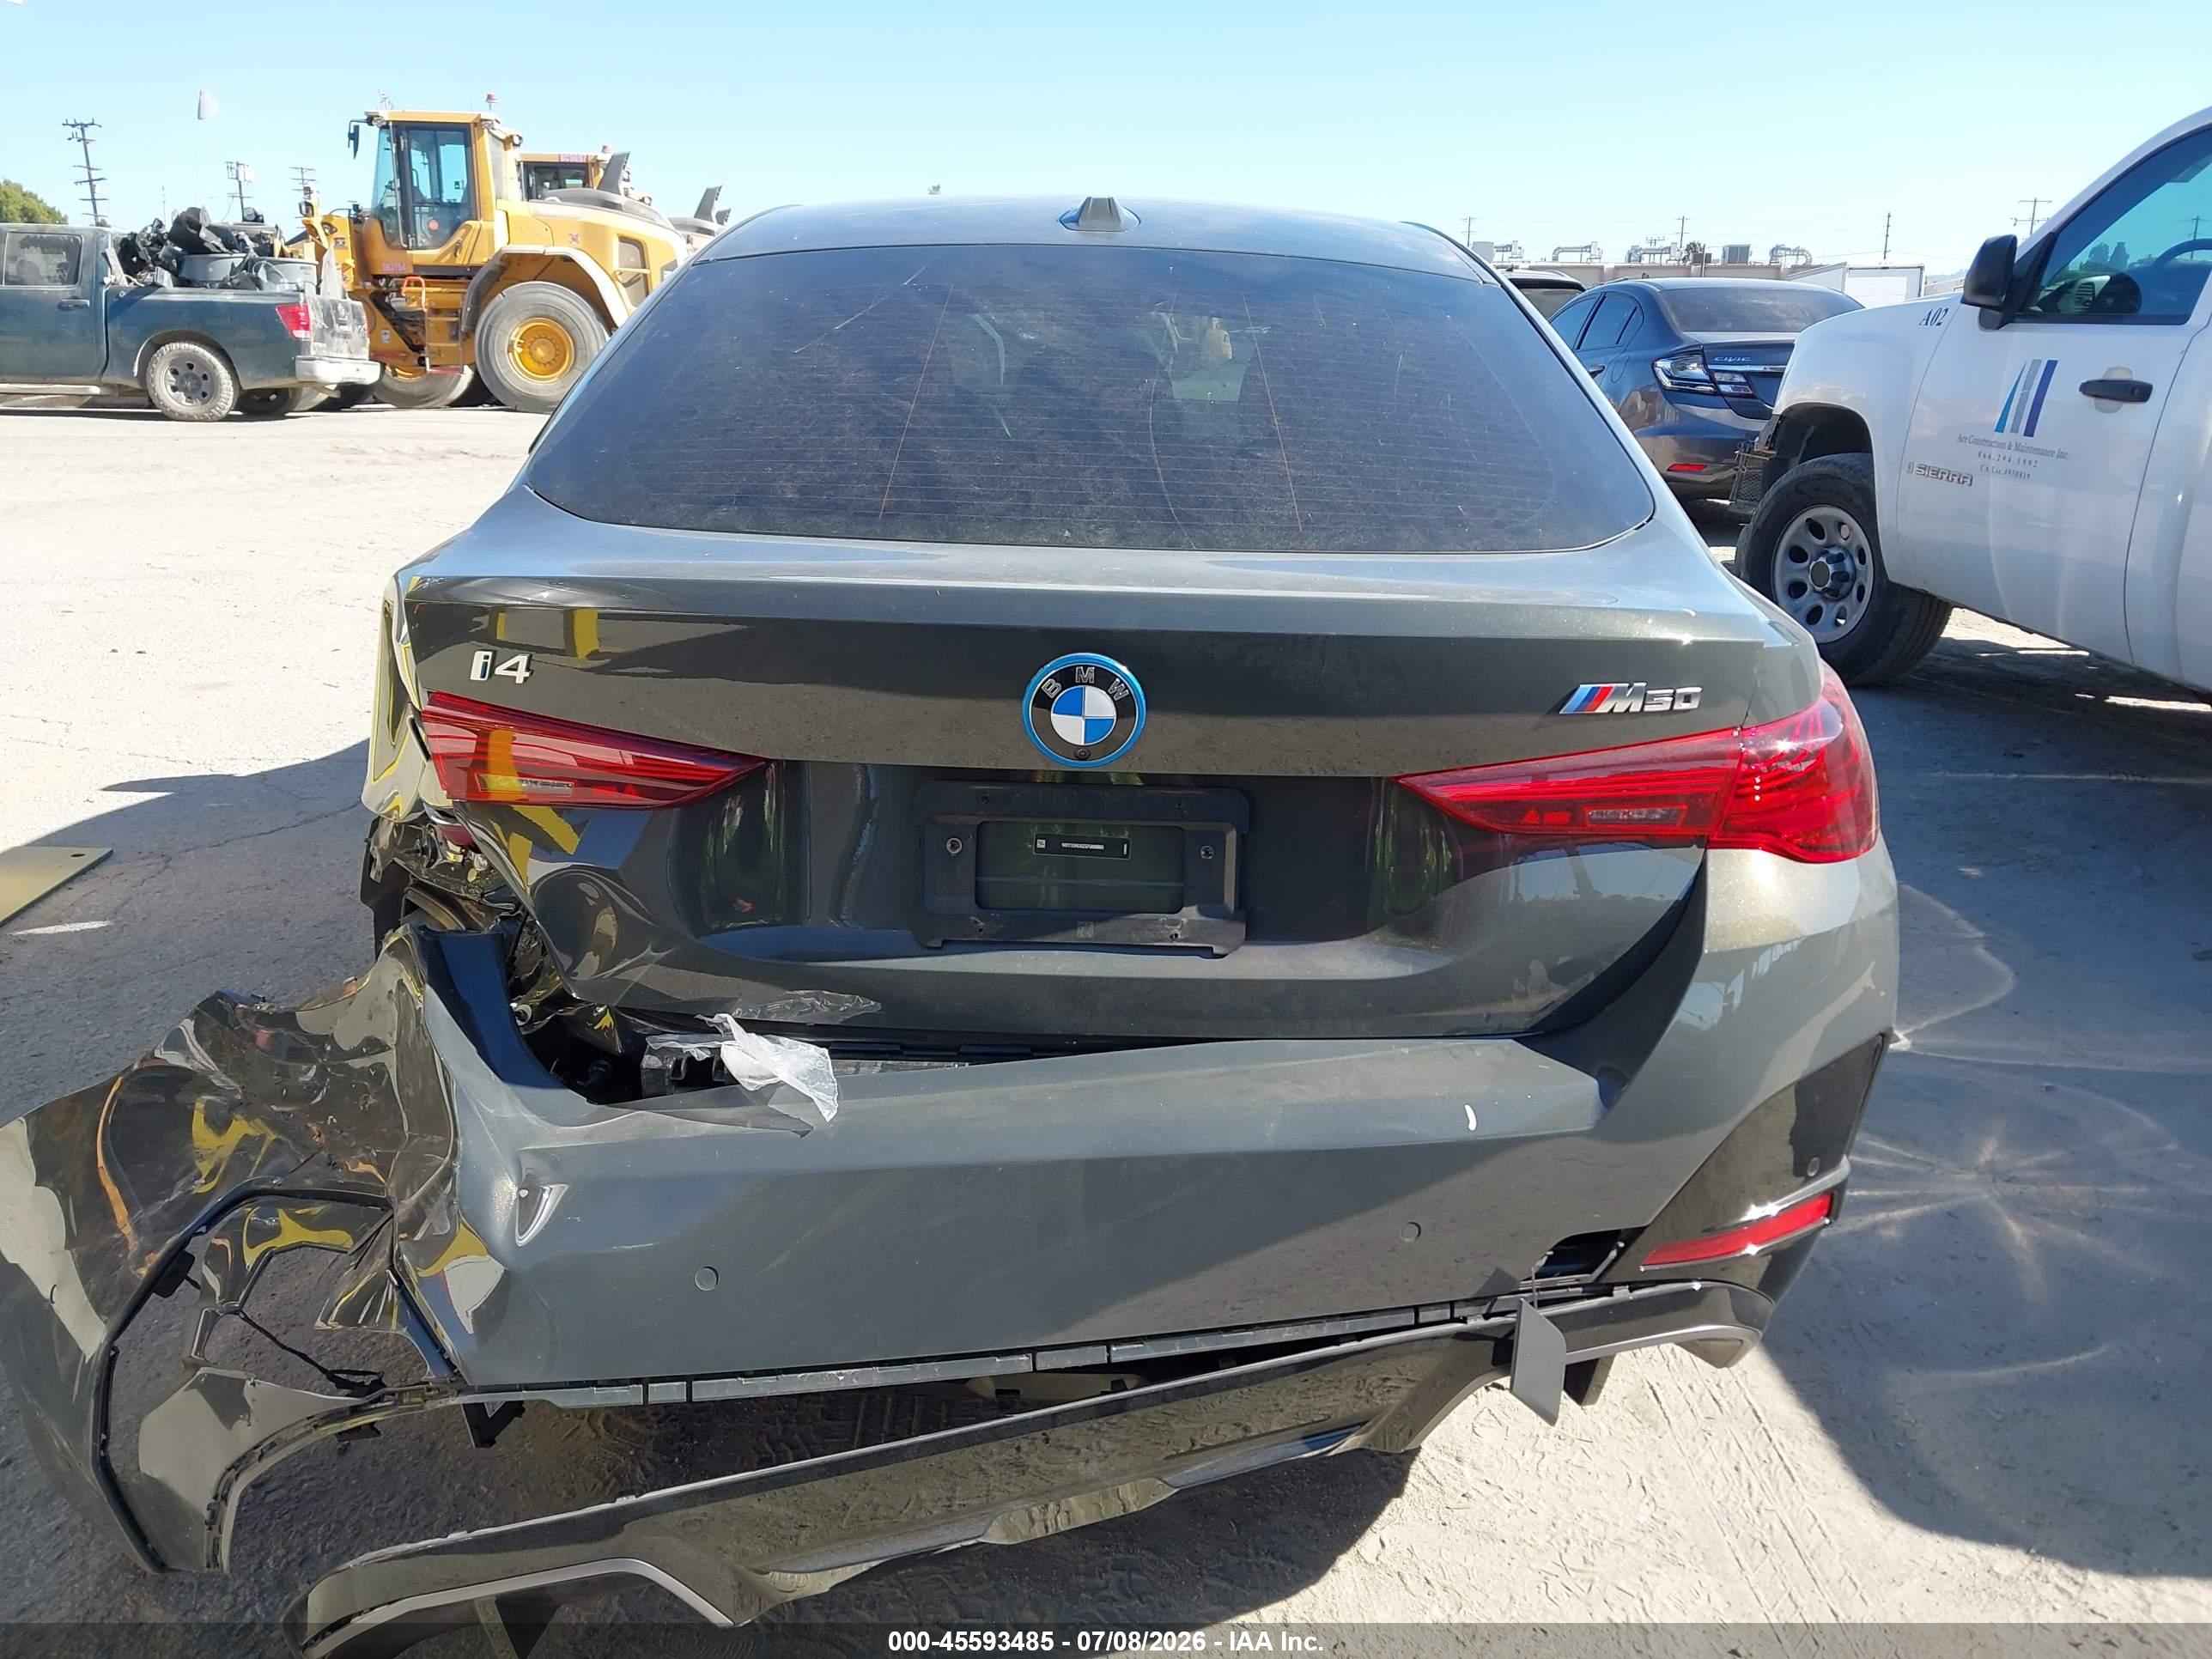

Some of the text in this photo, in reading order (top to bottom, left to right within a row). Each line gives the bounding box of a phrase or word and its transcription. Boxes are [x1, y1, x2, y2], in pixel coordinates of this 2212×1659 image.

[1918, 307, 1949, 326] A02
[1968, 434, 2006, 450] Construction
[2014, 441, 2056, 458] Maintenance
[1915, 463, 1973, 487] SIERRA
[470, 650, 532, 684] i4
[1041, 665, 1130, 702] BMW
[1595, 682, 1704, 714] M50
